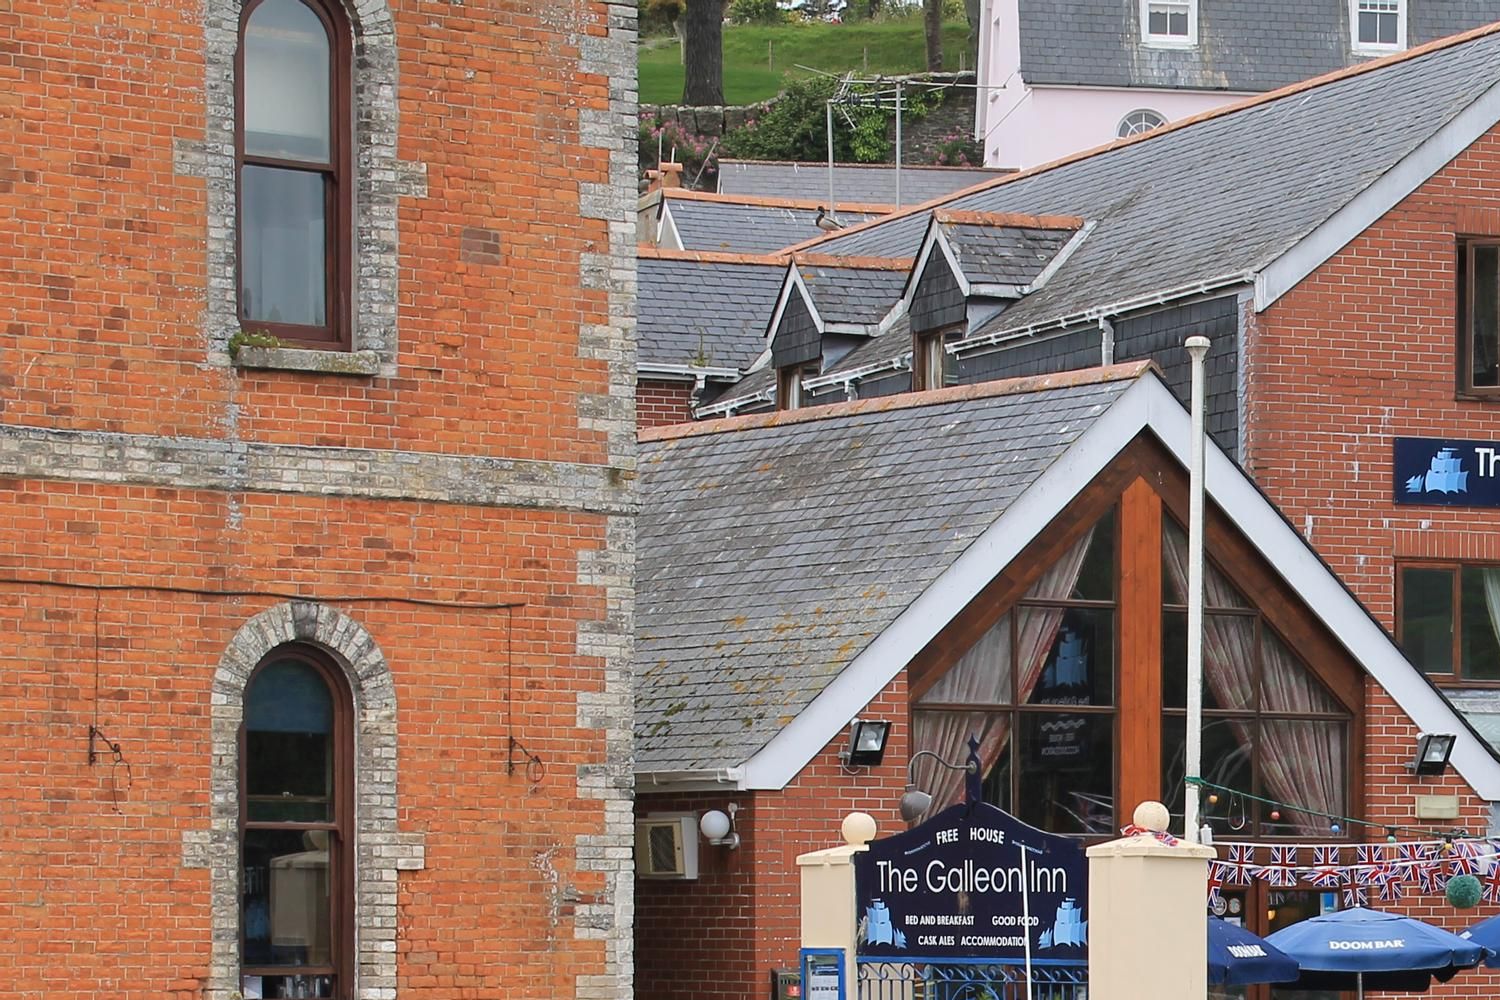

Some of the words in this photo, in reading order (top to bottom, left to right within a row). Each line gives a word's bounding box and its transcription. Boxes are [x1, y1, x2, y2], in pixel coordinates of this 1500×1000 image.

[936, 828, 959, 845] FREE
[969, 827, 1005, 845] HOUSE
[876, 860, 918, 893] The
[925, 859, 1022, 893] Galleon
[1030, 860, 1067, 893] Inn
[905, 915, 918, 926] BED
[919, 915, 935, 926] AND
[936, 915, 975, 926] BREAKFAST
[992, 915, 1016, 927] GOOD
[1017, 916, 1039, 927] FOOD
[918, 935, 937, 946] CASK
[938, 935, 955, 946] ALES
[1328, 940, 1374, 950] DOOM
[1375, 940, 1404, 949] BAR
